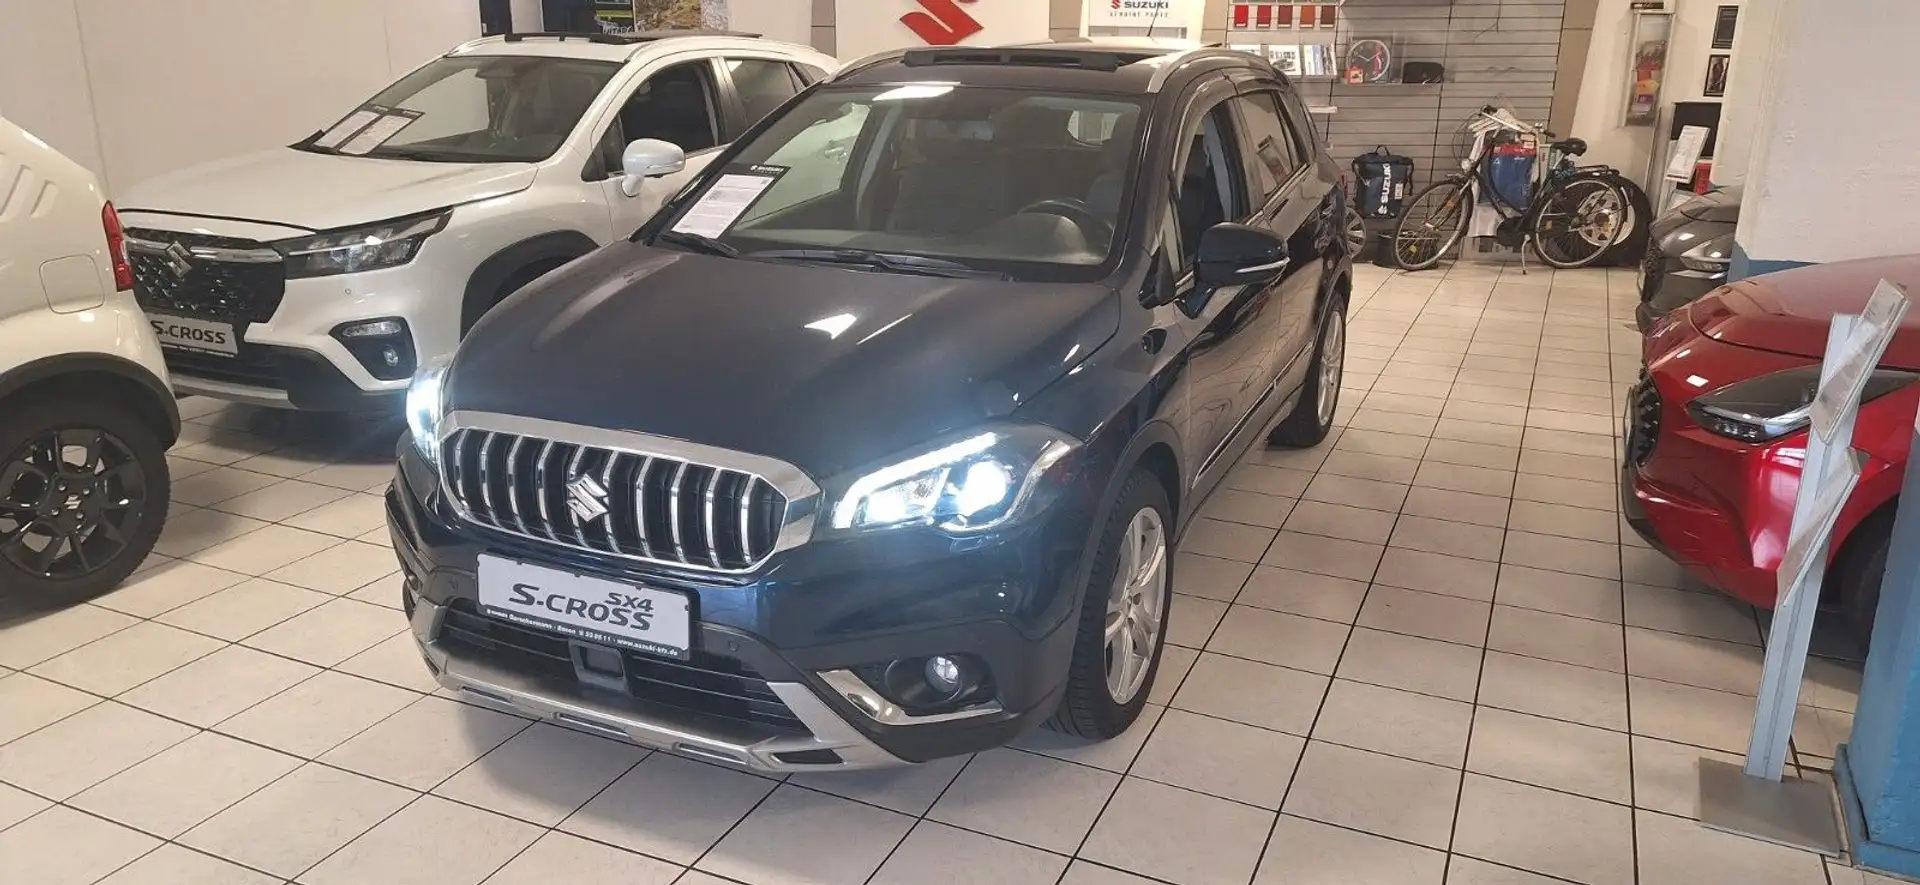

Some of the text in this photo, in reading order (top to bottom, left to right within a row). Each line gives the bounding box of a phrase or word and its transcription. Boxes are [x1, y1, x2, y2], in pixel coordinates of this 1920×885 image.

[1124, 1, 1169, 9] SUZUKI
[1381, 163, 1391, 203] SUZUKI
[508, 583, 654, 631] S-CROSS
[604, 592, 654, 612] SX4
